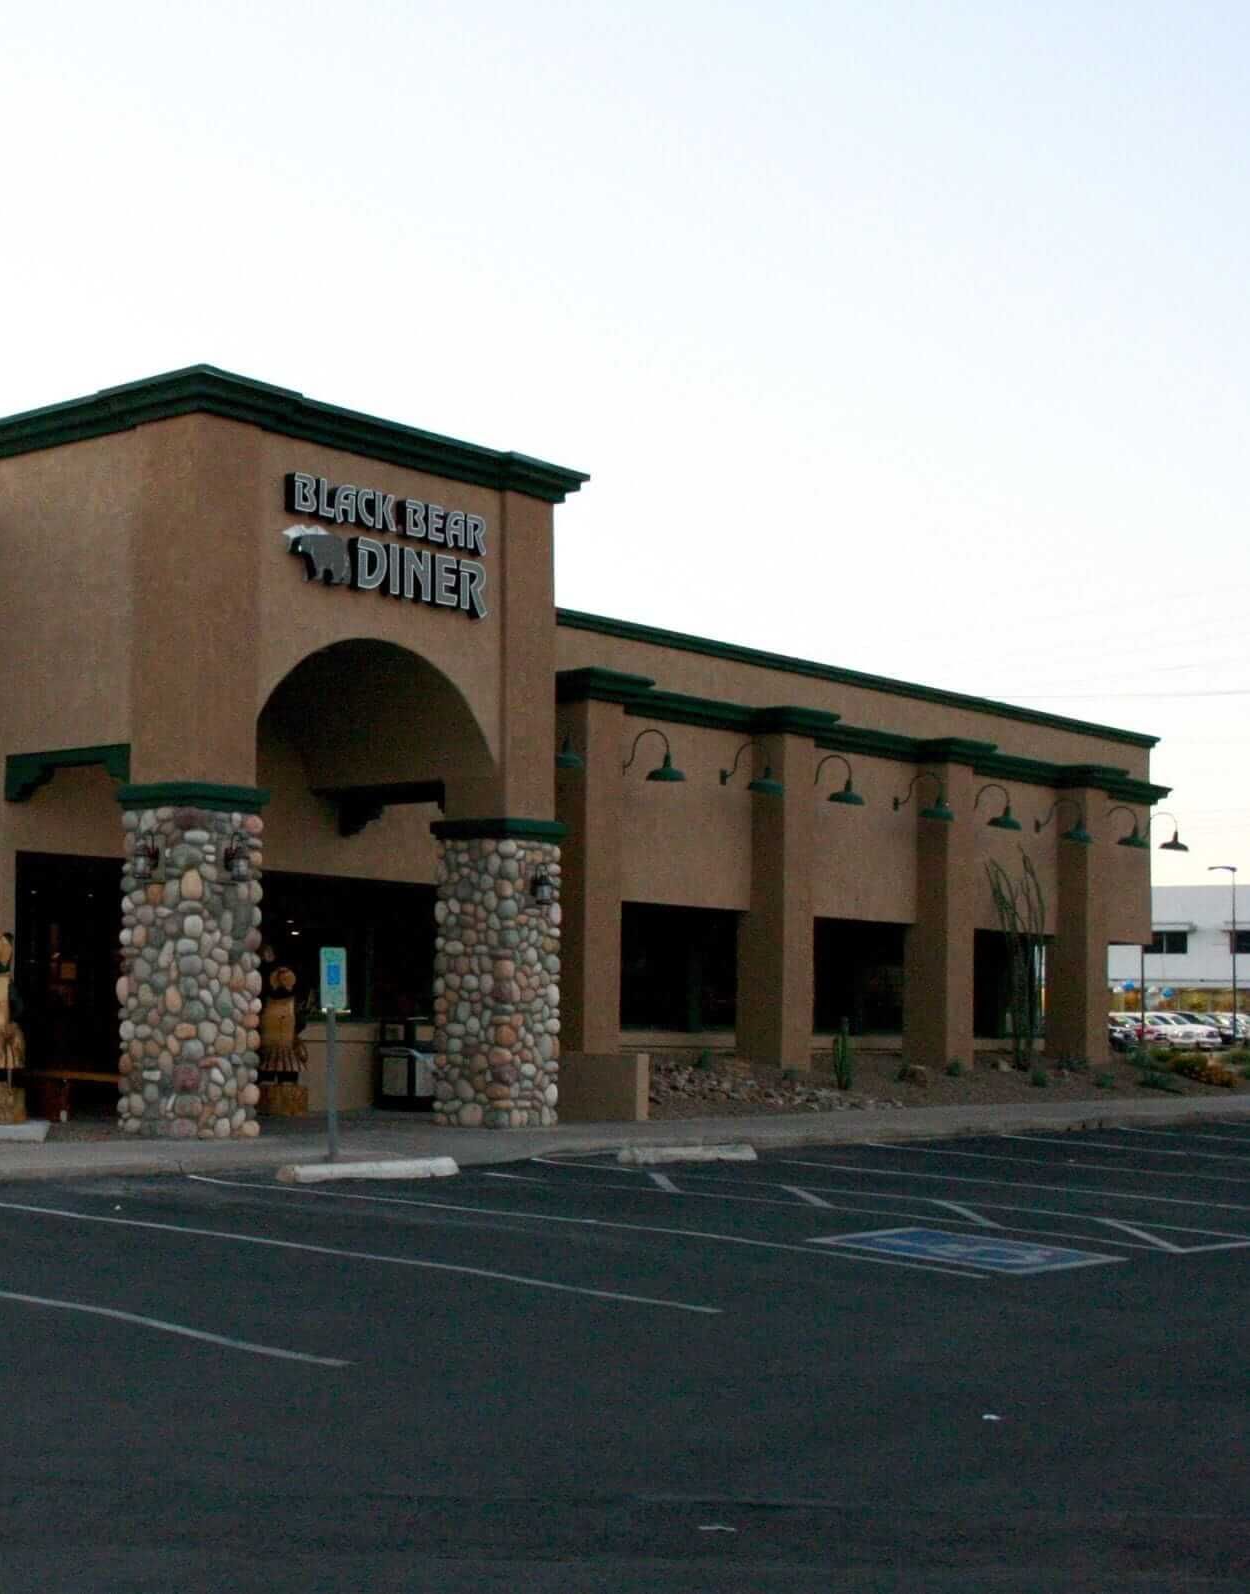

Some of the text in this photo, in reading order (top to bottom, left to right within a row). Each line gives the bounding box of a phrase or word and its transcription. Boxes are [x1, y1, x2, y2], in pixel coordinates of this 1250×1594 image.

[291, 472, 487, 556] BLACK BEAR
[354, 536, 488, 618] DINER
